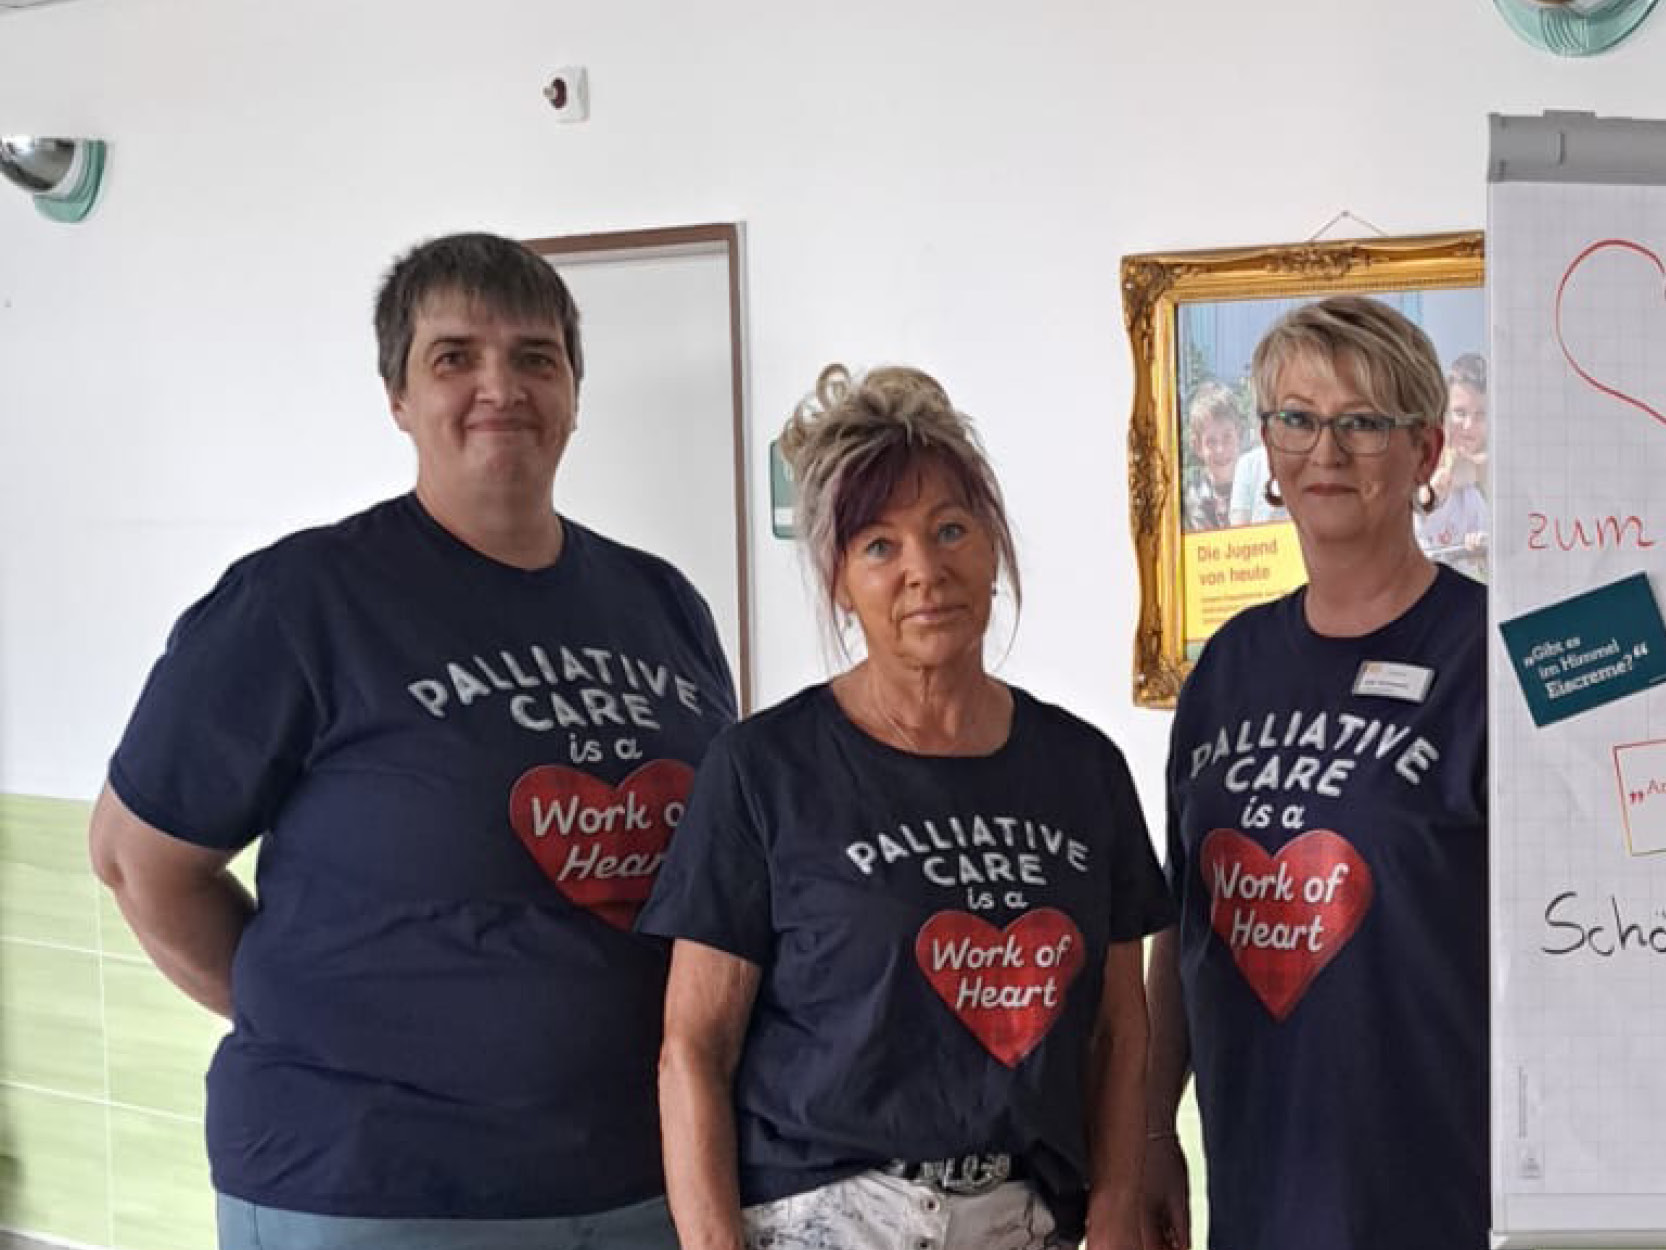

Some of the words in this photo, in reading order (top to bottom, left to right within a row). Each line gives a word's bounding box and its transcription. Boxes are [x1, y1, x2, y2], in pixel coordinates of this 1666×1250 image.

[1198, 545, 1221, 562] Die
[1224, 538, 1278, 561] Jugend
[1527, 510, 1656, 551] zum
[1199, 571, 1225, 587] von
[1229, 564, 1272, 582] heute
[1538, 663, 1561, 680] im
[1559, 637, 1621, 671] Himmel
[1565, 636, 1581, 650] es
[407, 645, 702, 719] PALLIATIVE
[509, 687, 661, 731] CARE
[568, 732, 602, 764] is
[614, 736, 643, 760] a
[1189, 710, 1440, 785] PALLIATIVE
[1224, 754, 1356, 797] CARE
[530, 790, 652, 838] Work
[662, 800, 686, 828] o
[1241, 795, 1273, 829] is
[1281, 804, 1306, 829] a
[556, 842, 664, 882] Hear
[845, 814, 1089, 876] PALLIATIVE
[922, 852, 1047, 887] CARE
[1212, 860, 1295, 901] Work
[1303, 862, 1350, 904] of
[967, 886, 995, 910] is
[1004, 890, 1030, 909] a
[1229, 907, 1325, 953] Heart
[931, 933, 1025, 972] Work
[1034, 933, 1073, 968] of
[954, 975, 1058, 1012] Heart
